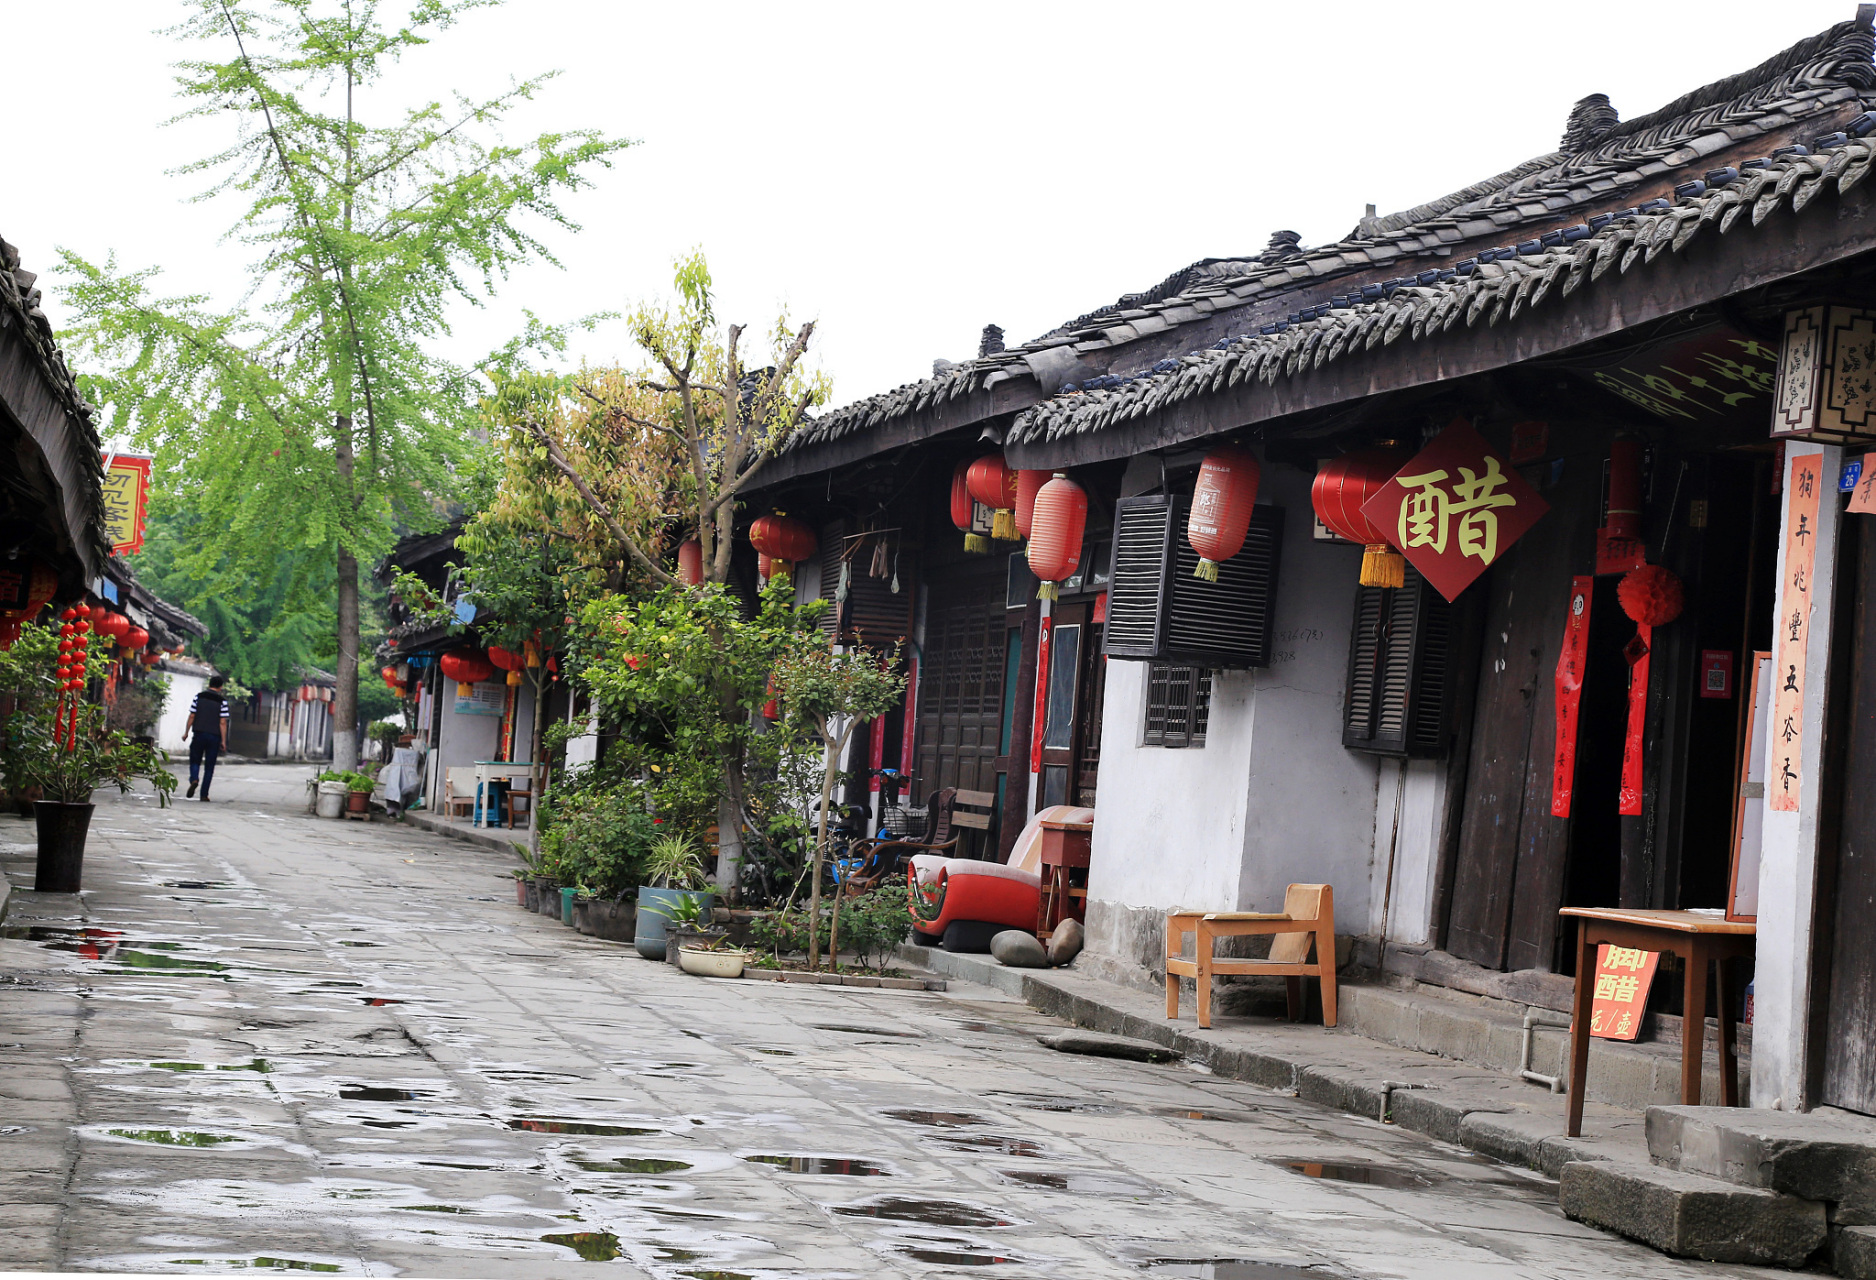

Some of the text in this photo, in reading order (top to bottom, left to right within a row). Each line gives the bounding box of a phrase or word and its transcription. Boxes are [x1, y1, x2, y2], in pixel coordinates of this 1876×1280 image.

[1845, 474, 1854, 487] 26
[1396, 456, 1516, 565] 醋
[1594, 974, 1639, 1003] 醋
